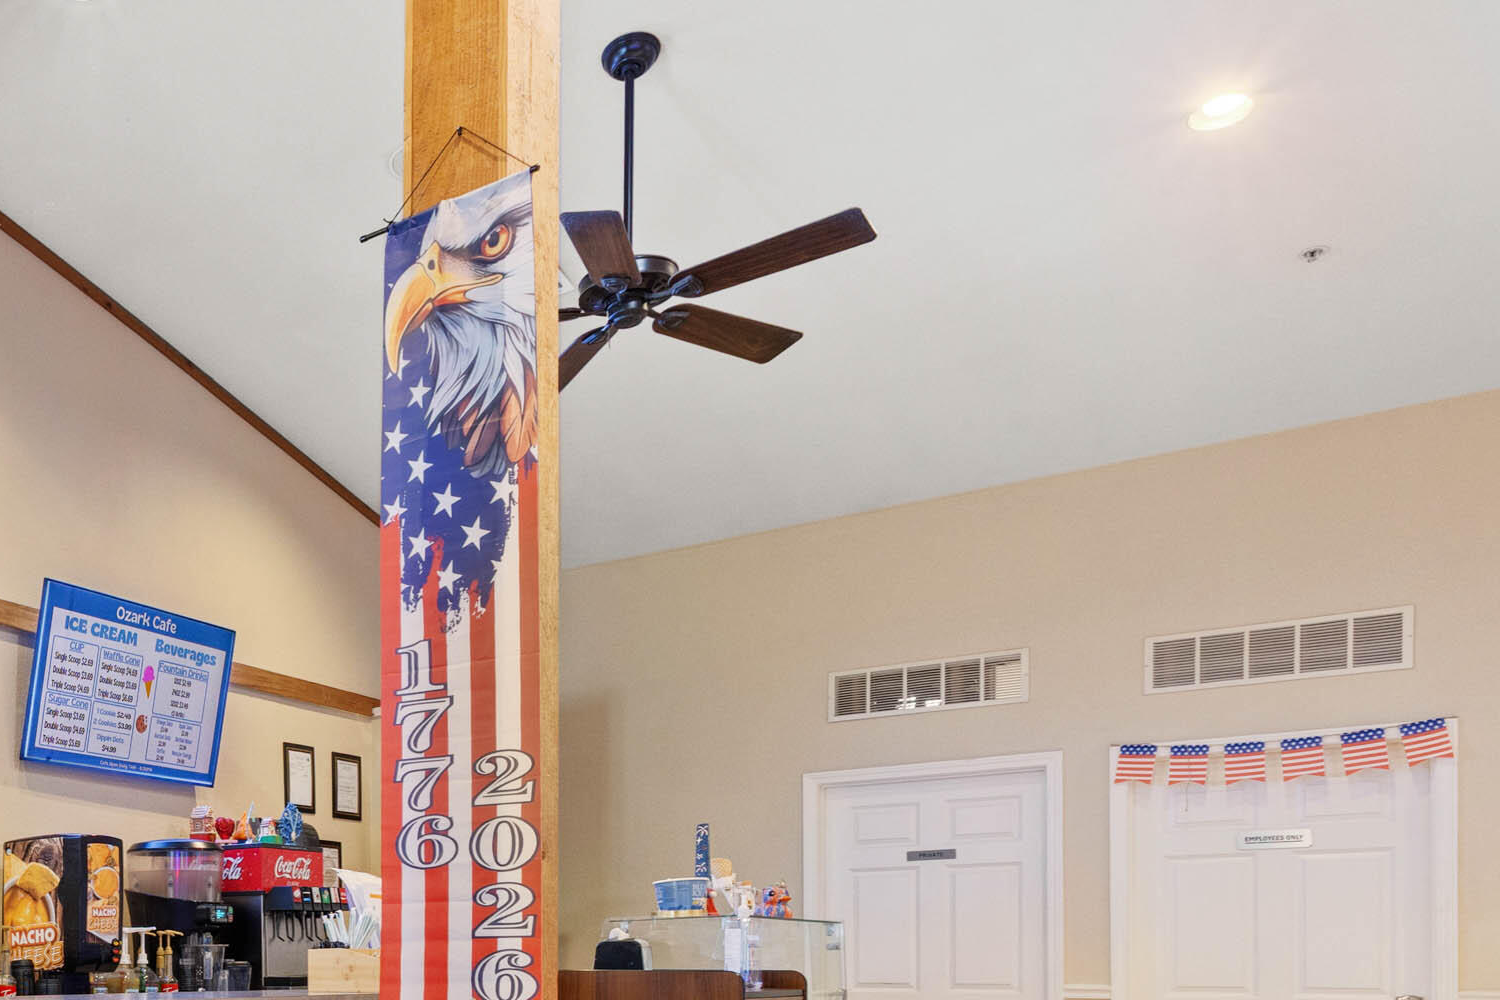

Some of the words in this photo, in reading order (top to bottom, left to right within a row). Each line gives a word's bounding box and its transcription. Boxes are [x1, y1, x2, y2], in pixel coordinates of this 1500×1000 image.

[116, 605, 151, 628] Ozark
[152, 616, 177, 635] Cafe
[64, 615, 87, 633] ICE
[90, 622, 138, 647] CREAM
[53, 651, 67, 663] Single
[67, 654, 81, 666] Scoop
[155, 638, 217, 667] Beverages
[51, 664, 67, 677] Double
[66, 667, 81, 679] Scoop
[100, 661, 113, 673] Single
[112, 664, 126, 676] Scoop
[157, 662, 188, 678] Fountain
[50, 678, 63, 690] Triple
[62, 681, 77, 693] Scoop
[98, 674, 113, 686] Double
[112, 677, 125, 689] Scoop
[47, 693, 70, 707] Sugar
[70, 697, 89, 709] Cone
[96, 688, 109, 699] Triple
[108, 690, 122, 702] Scoop
[45, 706, 59, 718] Single
[58, 709, 73, 720] Scoop
[43, 719, 59, 732] Double
[58, 722, 72, 734] Scoop
[41, 733, 55, 744] Triple
[54, 735, 68, 747] Scoop
[394, 639, 458, 870] 1776
[1244, 835, 1285, 843] EMPLOYEES
[92, 907, 117, 917] NACHO
[11, 927, 56, 947] NACHO
